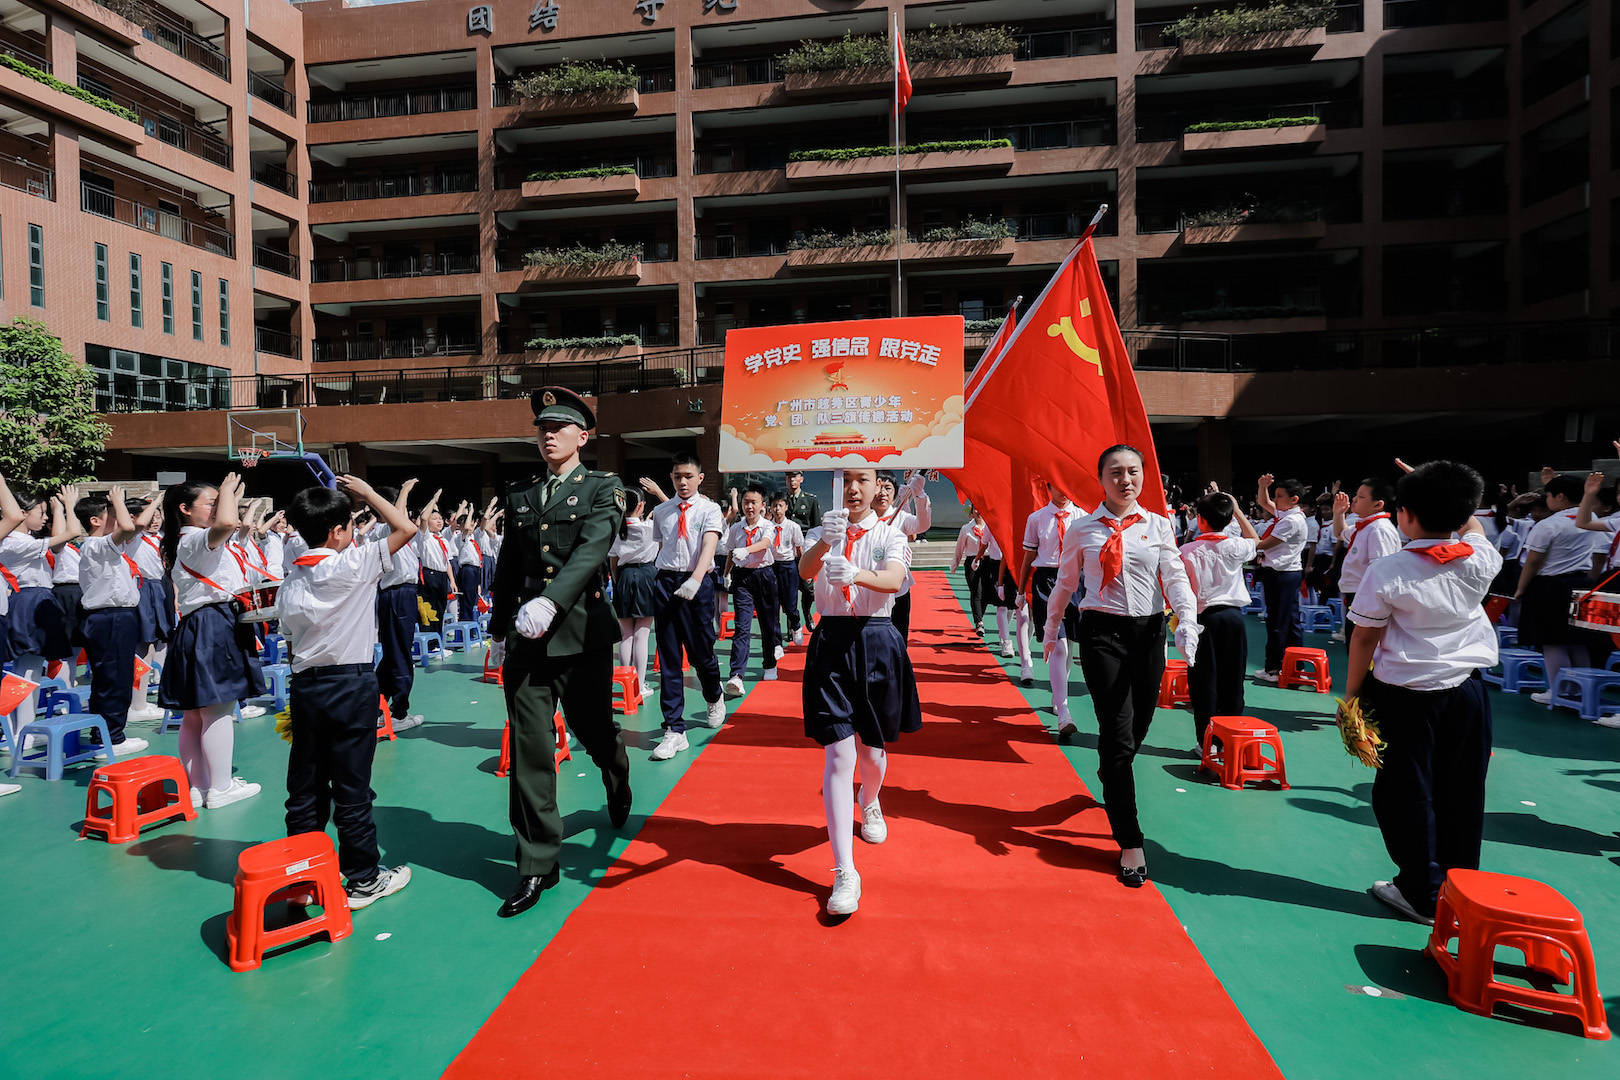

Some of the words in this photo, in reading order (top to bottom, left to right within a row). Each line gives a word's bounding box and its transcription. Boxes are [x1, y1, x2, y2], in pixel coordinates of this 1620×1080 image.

[744, 344, 802, 374] 学党史
[811, 337, 870, 358] 强信念
[879, 337, 941, 367] 跟党走
[776, 395, 902, 412] 广州市越秀区青少年
